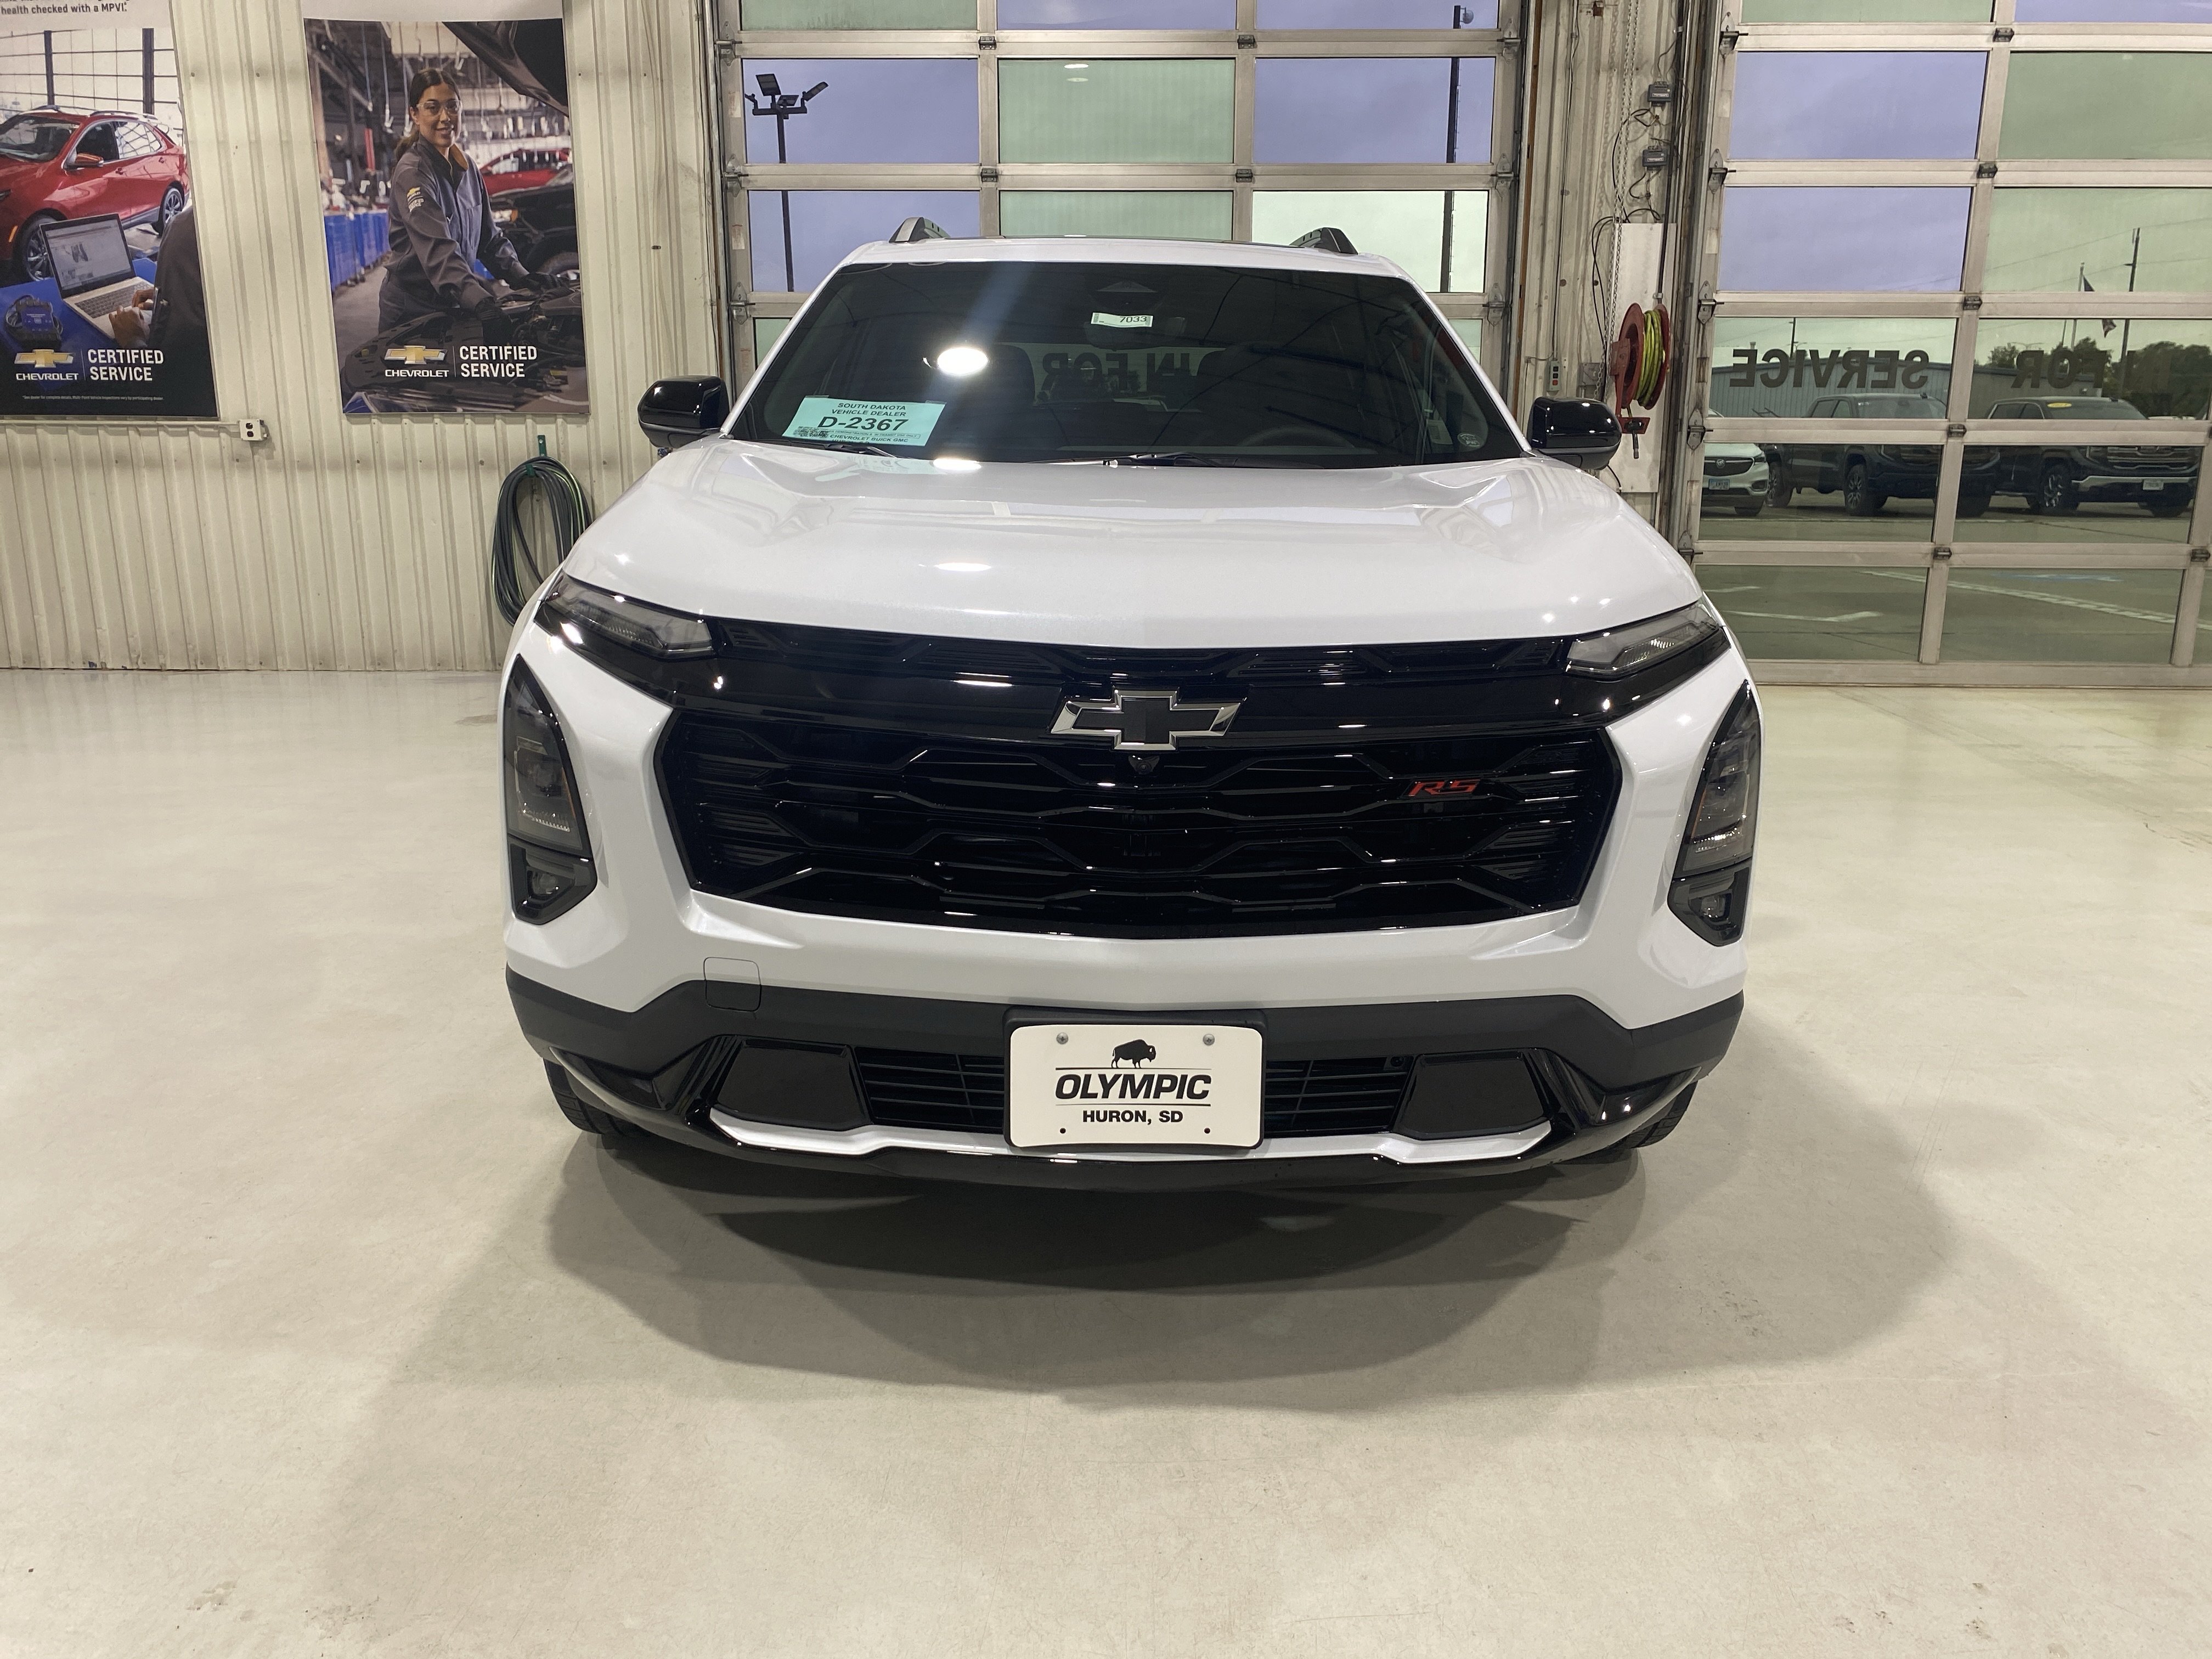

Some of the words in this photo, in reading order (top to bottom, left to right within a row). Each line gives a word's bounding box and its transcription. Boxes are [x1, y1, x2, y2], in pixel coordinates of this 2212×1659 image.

[1, 5, 29, 15] health
[31, 4, 68, 14] checked
[71, 4, 91, 13] with
[88, 349, 164, 364] CERTIFIED
[459, 346, 537, 360] CERTIFIED
[90, 366, 153, 381] SERVICE
[385, 369, 450, 377] CHEVROLET
[461, 363, 525, 377] SERVICE
[817, 416, 909, 431] D-2367
[1408, 778, 1481, 797] RS
[1055, 1074, 1212, 1099] OLYMPIC
[1082, 1110, 1152, 1125] HURON,
[1159, 1110, 1183, 1122] SD
